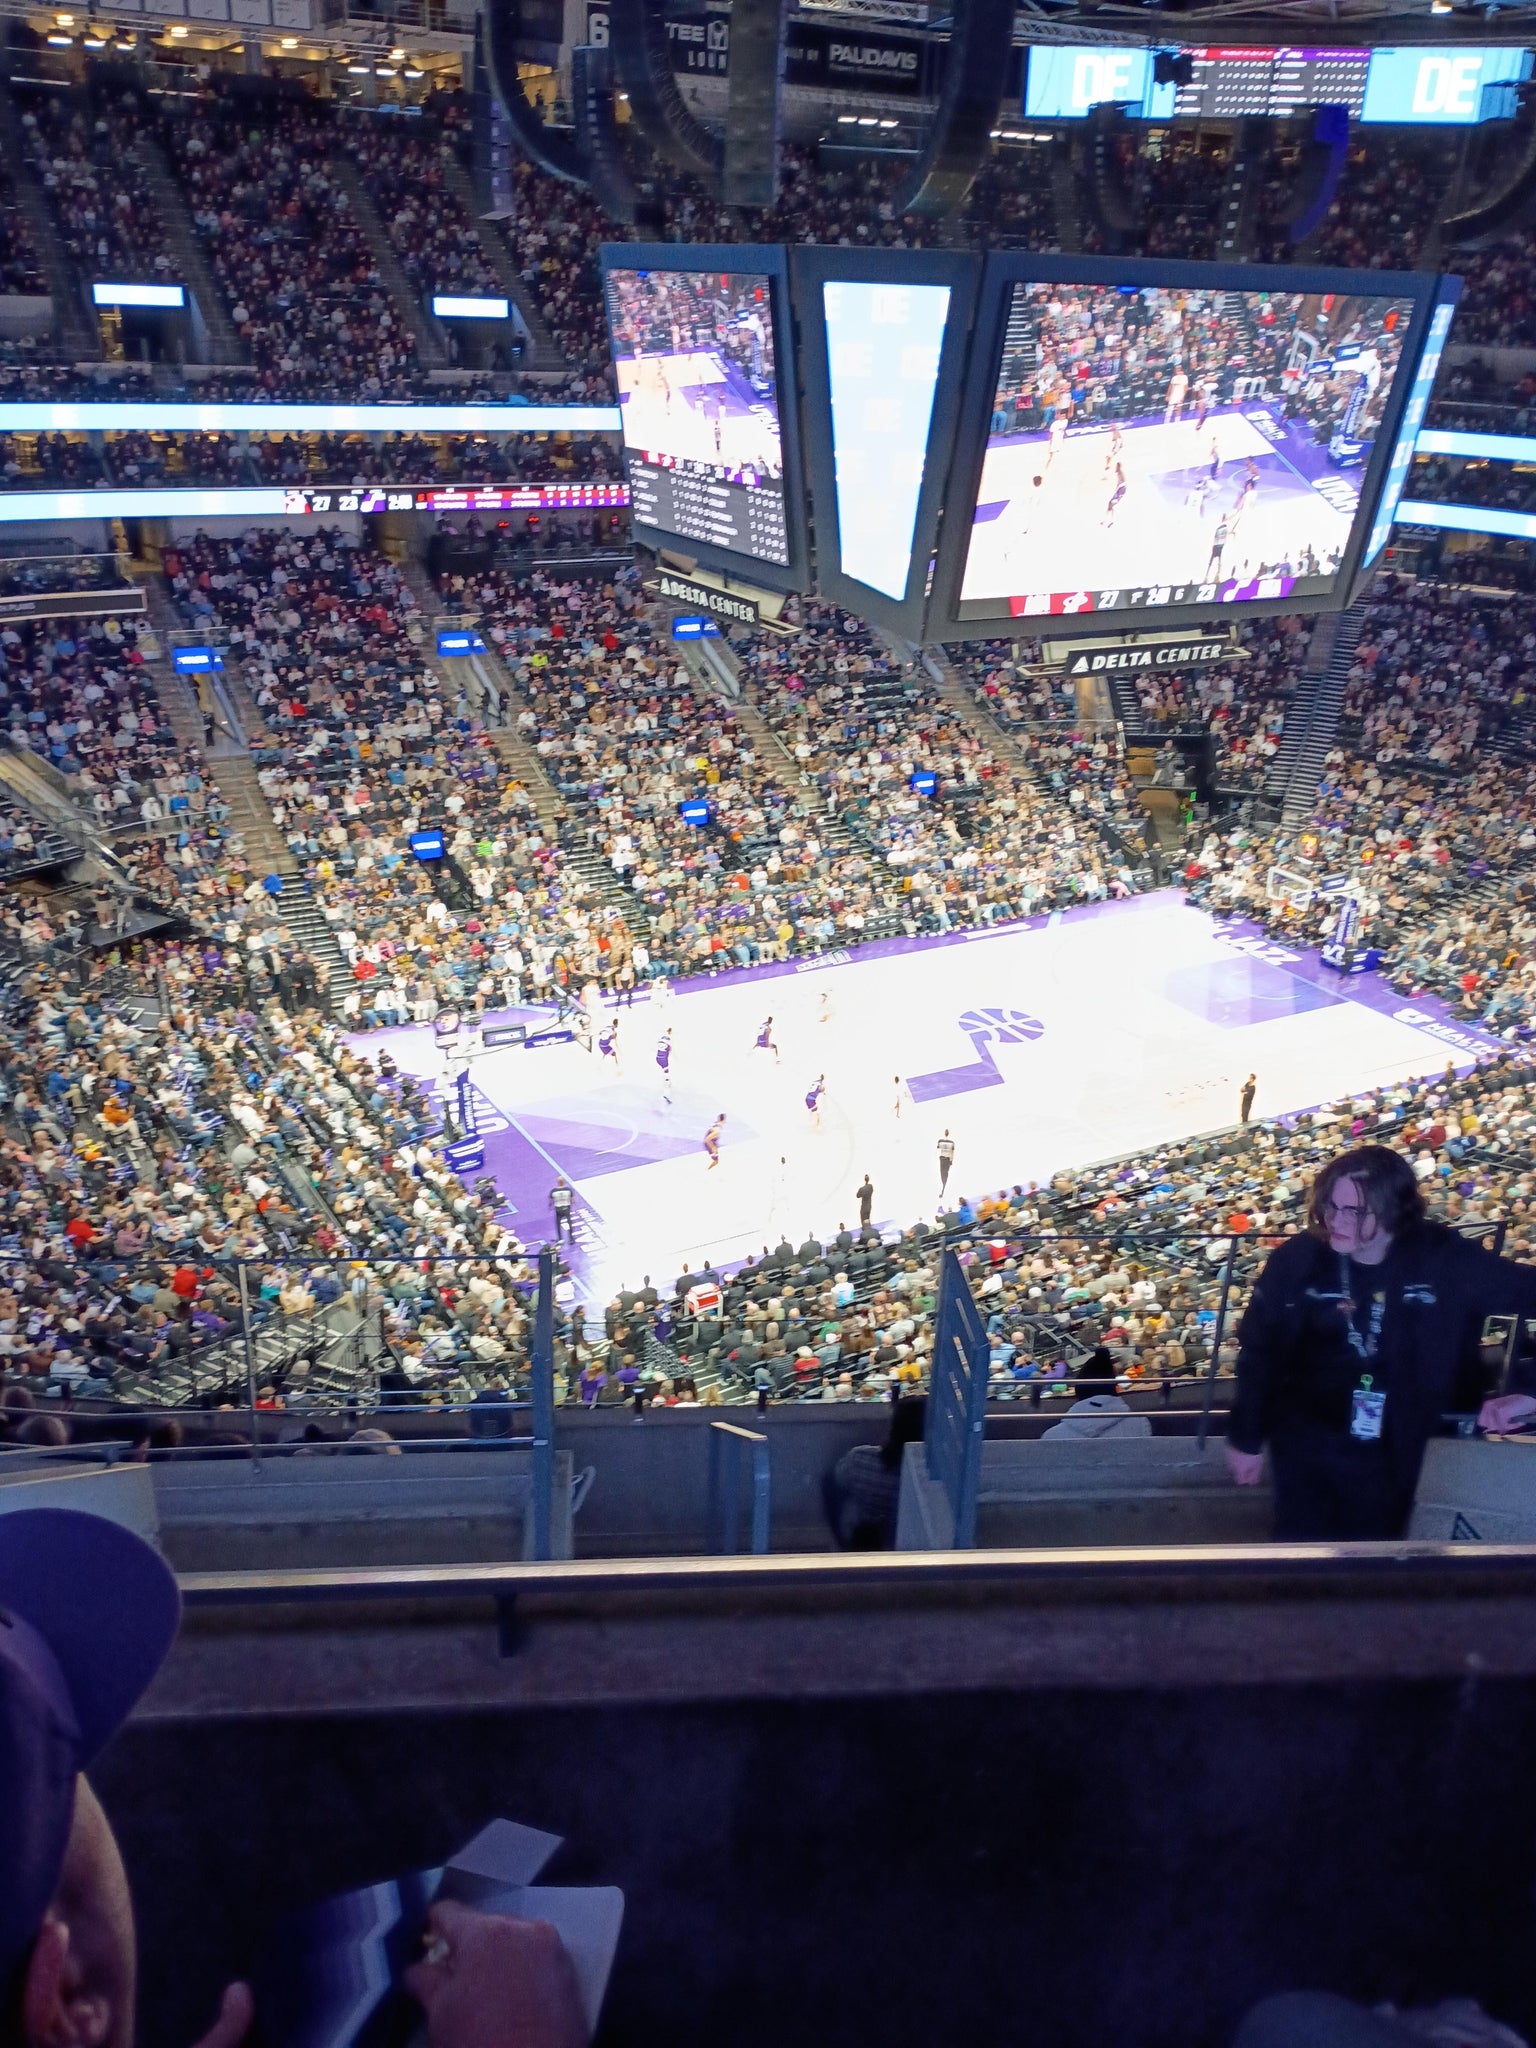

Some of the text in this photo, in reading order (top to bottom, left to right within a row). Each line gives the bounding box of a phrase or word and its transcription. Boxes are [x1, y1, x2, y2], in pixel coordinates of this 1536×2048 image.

[1412, 57, 1484, 113] DE
[671, 582, 756, 623] DELTA CENTER
[1098, 590, 1120, 609] 27
[1195, 584, 1217, 602] 23
[1091, 644, 1222, 671] DELTA CENTER
